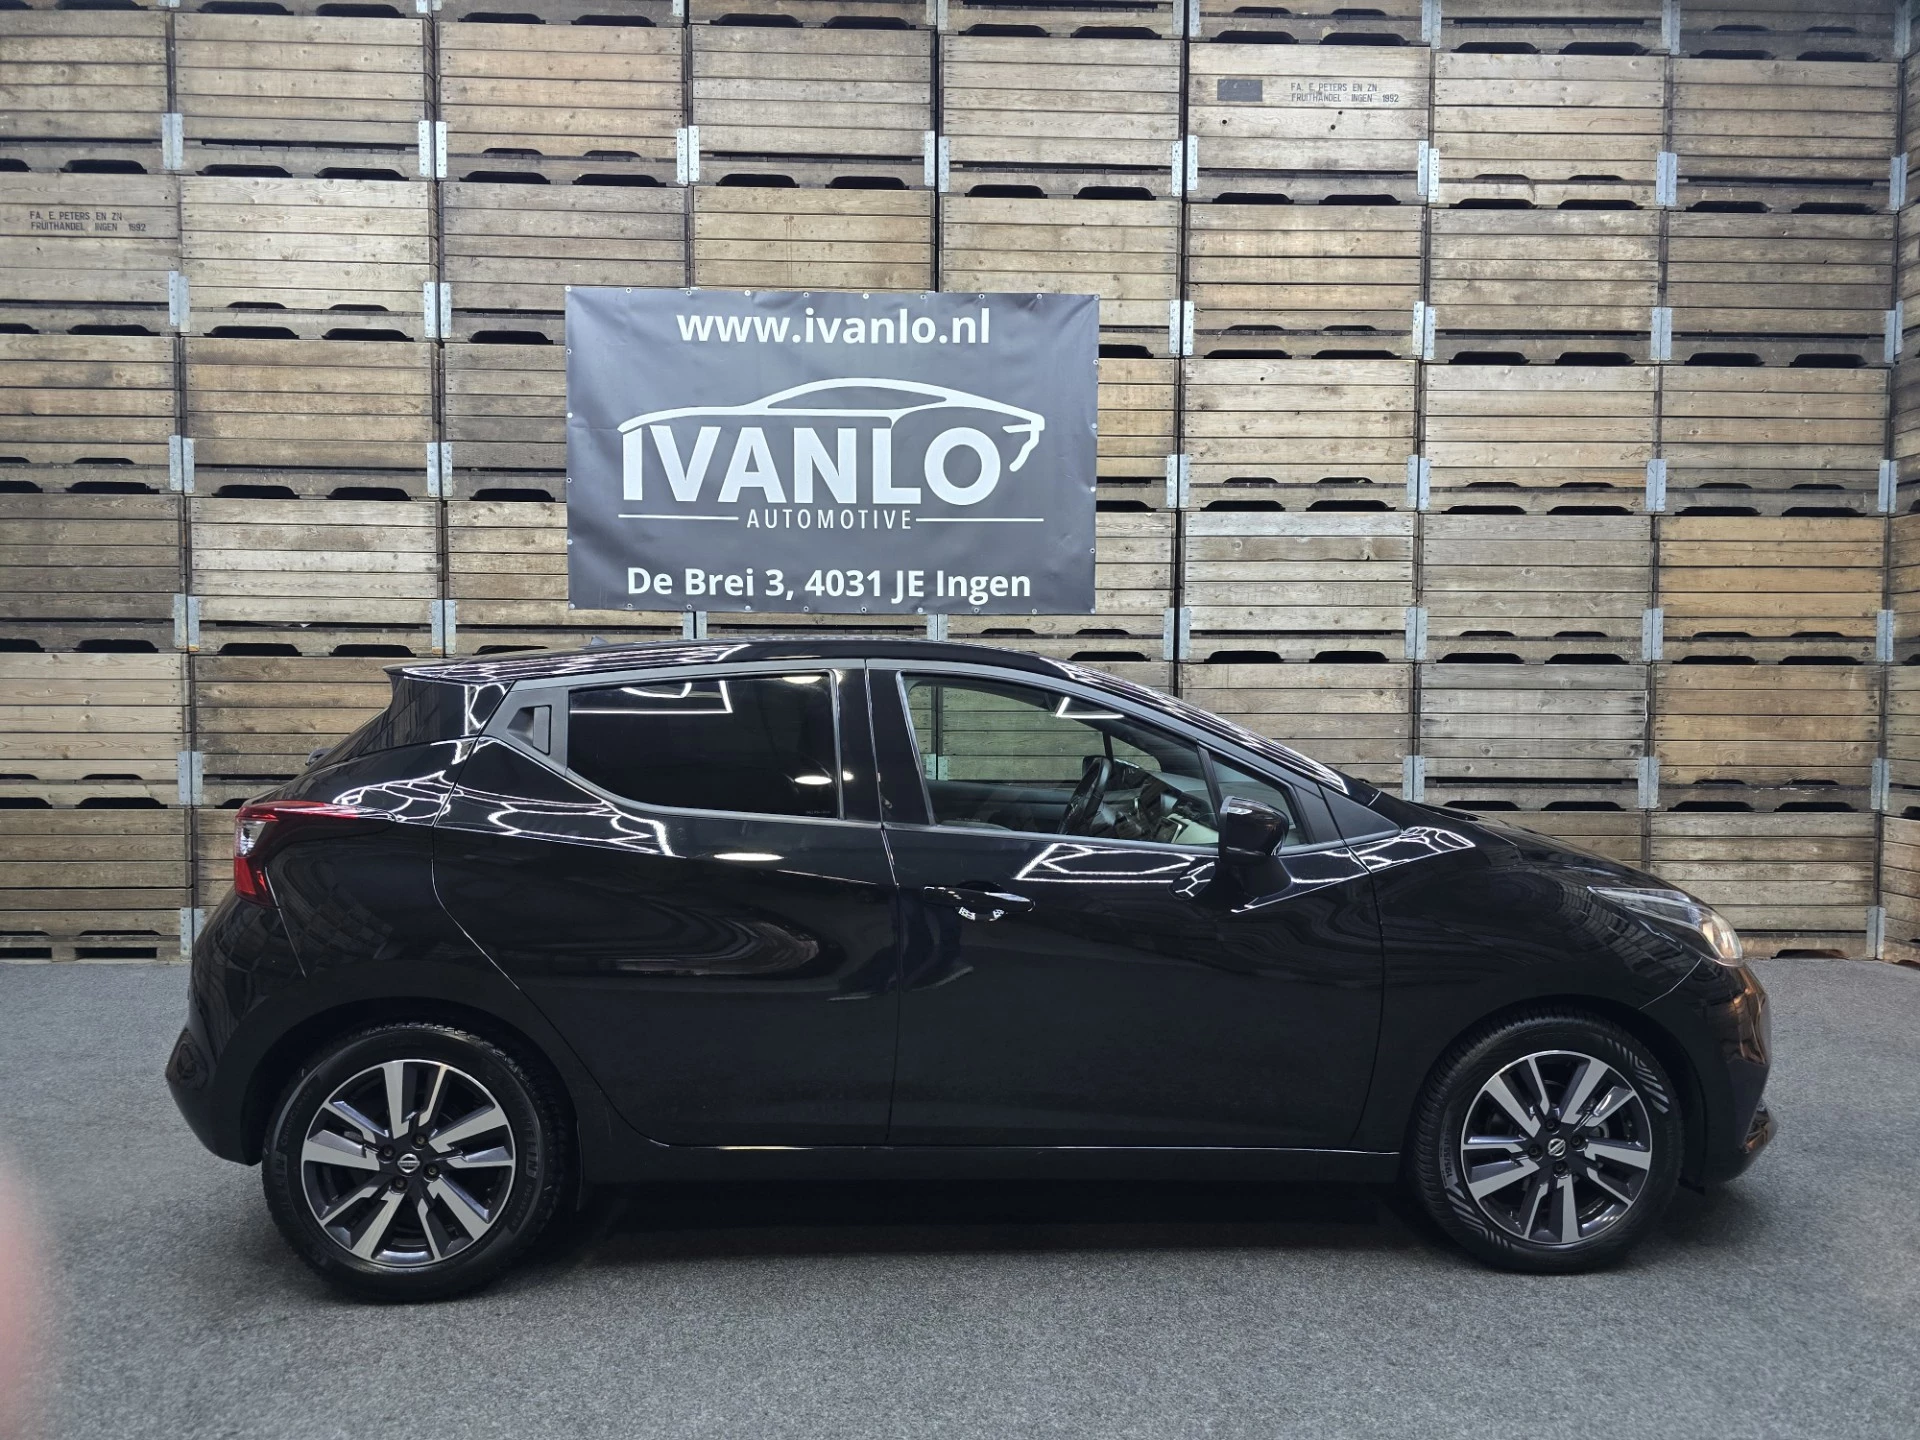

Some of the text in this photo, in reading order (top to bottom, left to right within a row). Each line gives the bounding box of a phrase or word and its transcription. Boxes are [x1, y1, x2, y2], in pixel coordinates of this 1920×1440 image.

[1319, 83, 1348, 93] PETERS
[1352, 83, 1364, 92] EN
[1367, 83, 1378, 92] ZN
[1291, 93, 1399, 103] FRUITHANDEL INGEN 1992
[59, 211, 91, 221] PETERS
[95, 212, 107, 221] EN
[111, 212, 123, 221] ZN
[31, 222, 85, 231] FRUITHANDEL
[94, 222, 118, 231] INGEN
[676, 307, 990, 344] www.ivanlo.nl
[622, 425, 1001, 506] IVANLO
[746, 508, 912, 530] AUTOMOTIVE
[627, 567, 1031, 606] De Brei 3, 4031 JE Ingen
